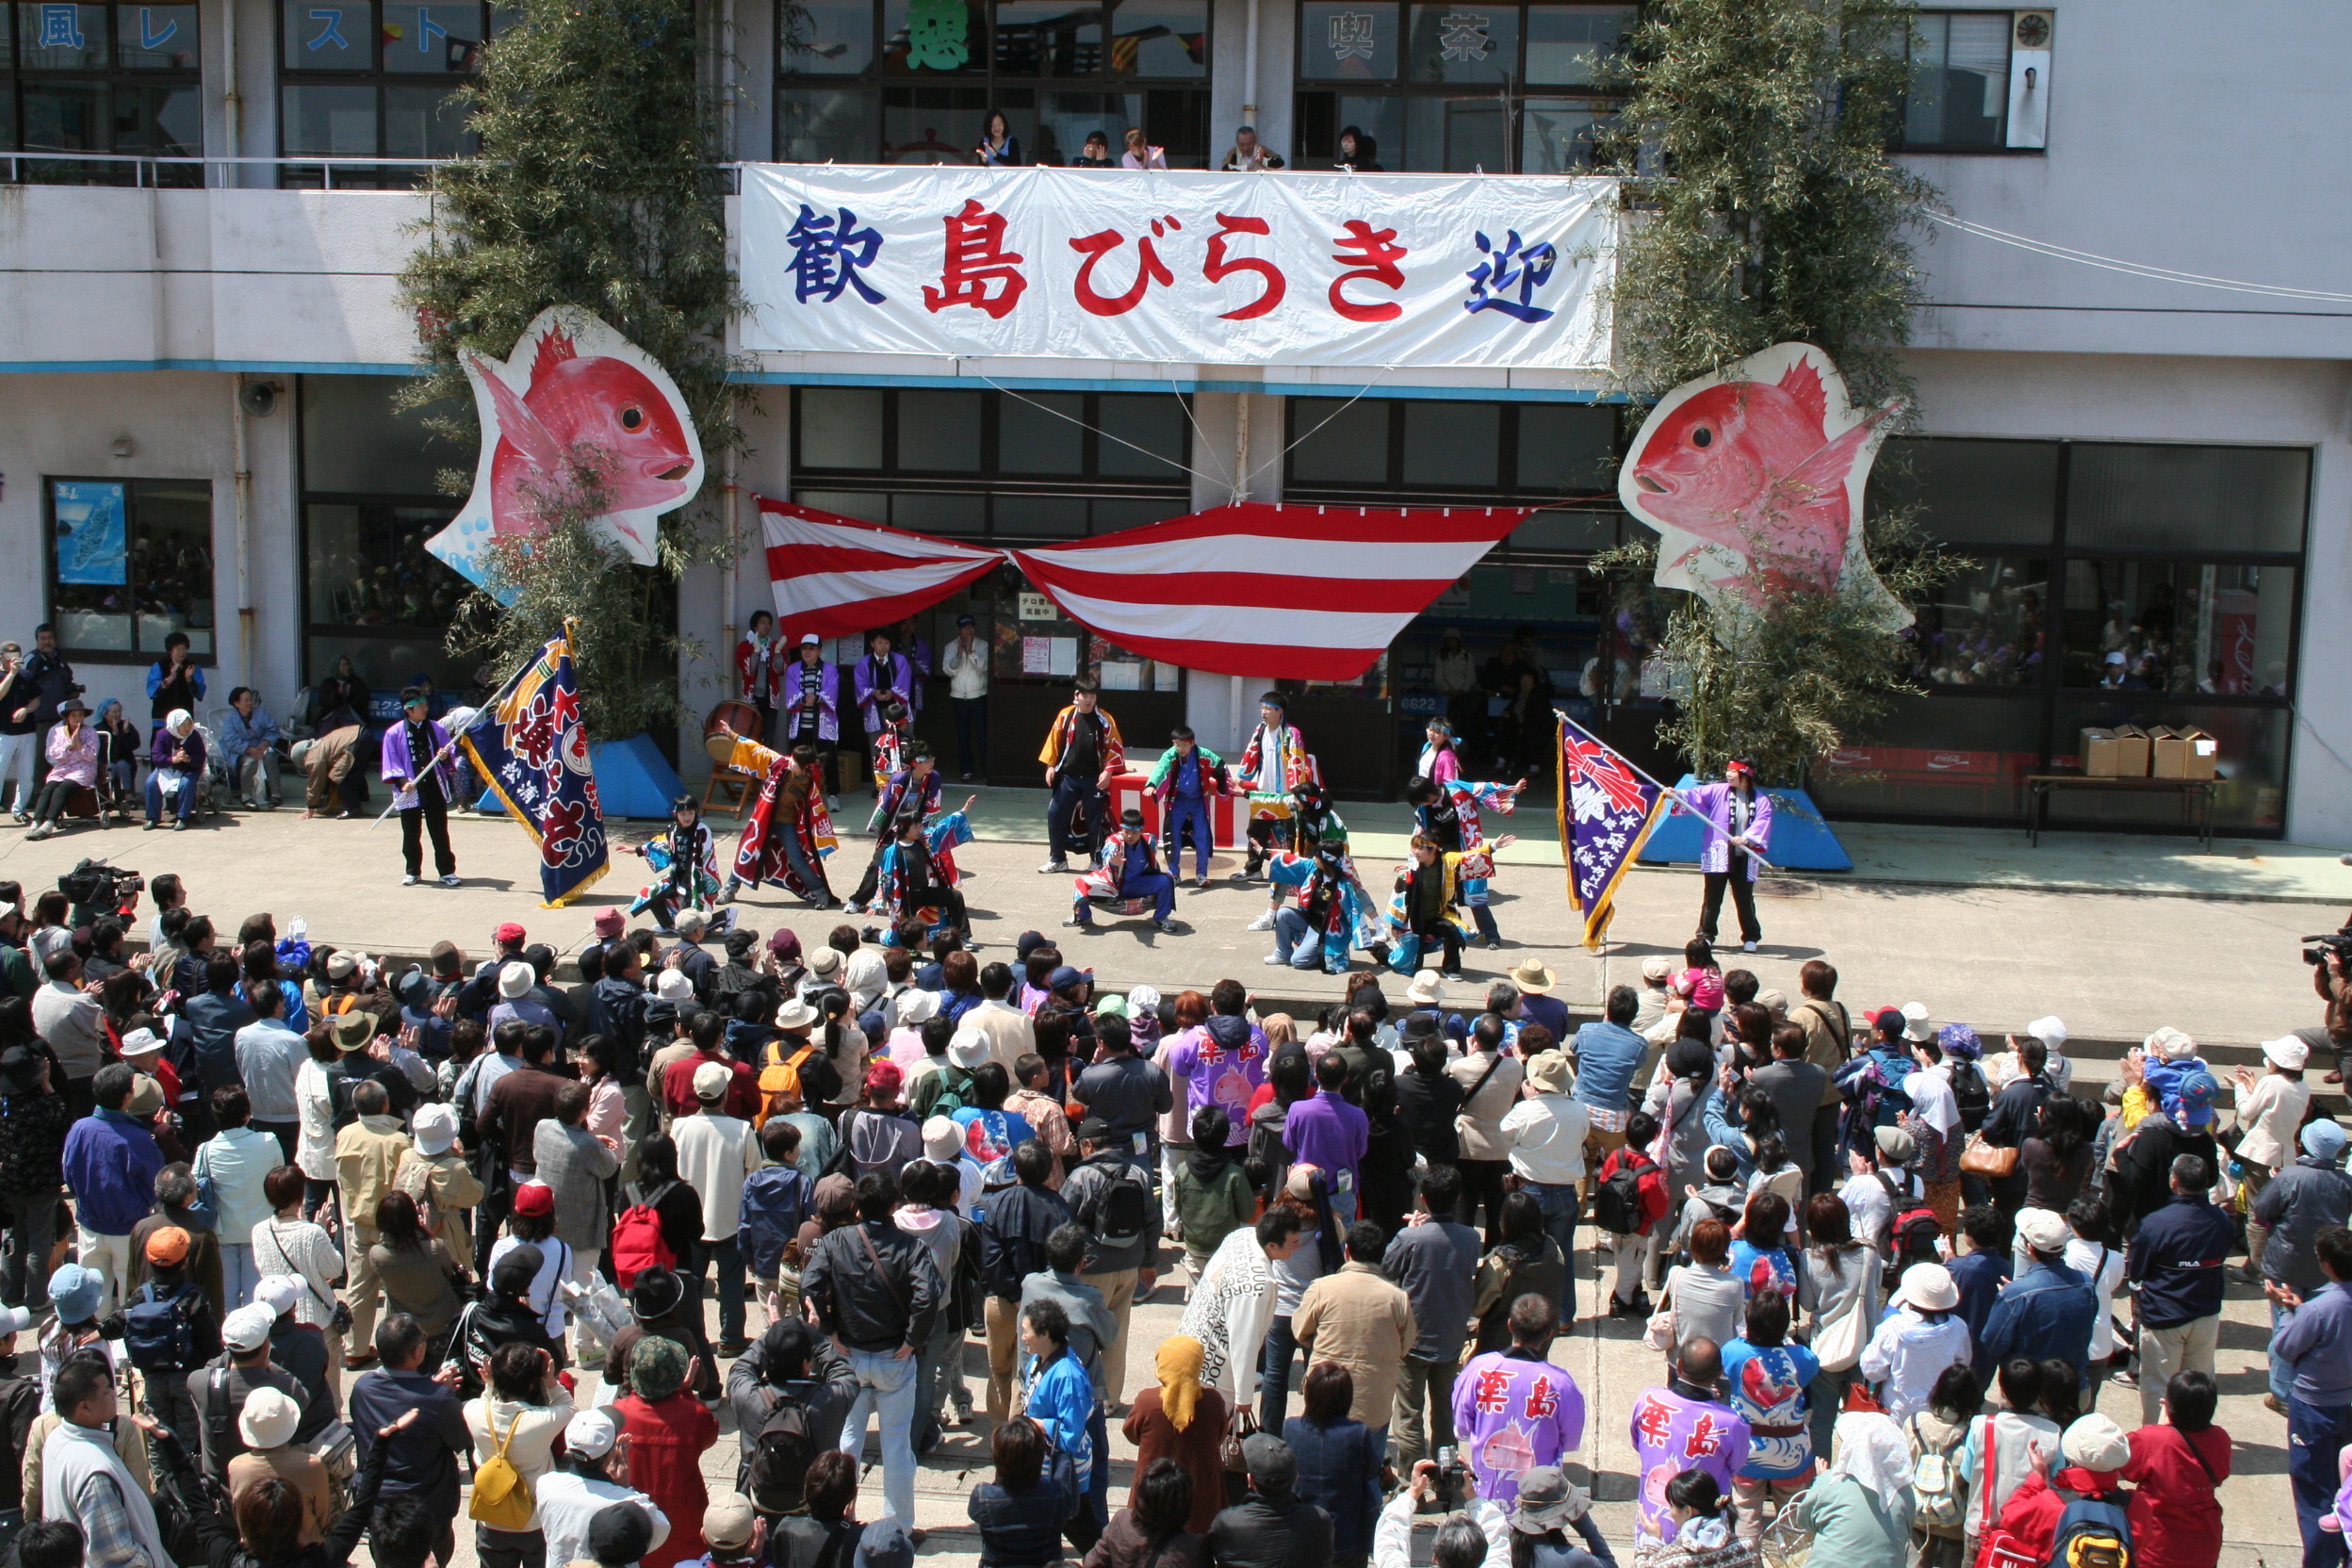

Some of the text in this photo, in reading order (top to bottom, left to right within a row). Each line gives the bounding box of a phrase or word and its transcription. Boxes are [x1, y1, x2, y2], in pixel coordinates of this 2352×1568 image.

[1329, 11, 1490, 61] 喫茶
[1476, 1367, 1560, 1420] 粟島
[1639, 1392, 1728, 1459] 粟島
